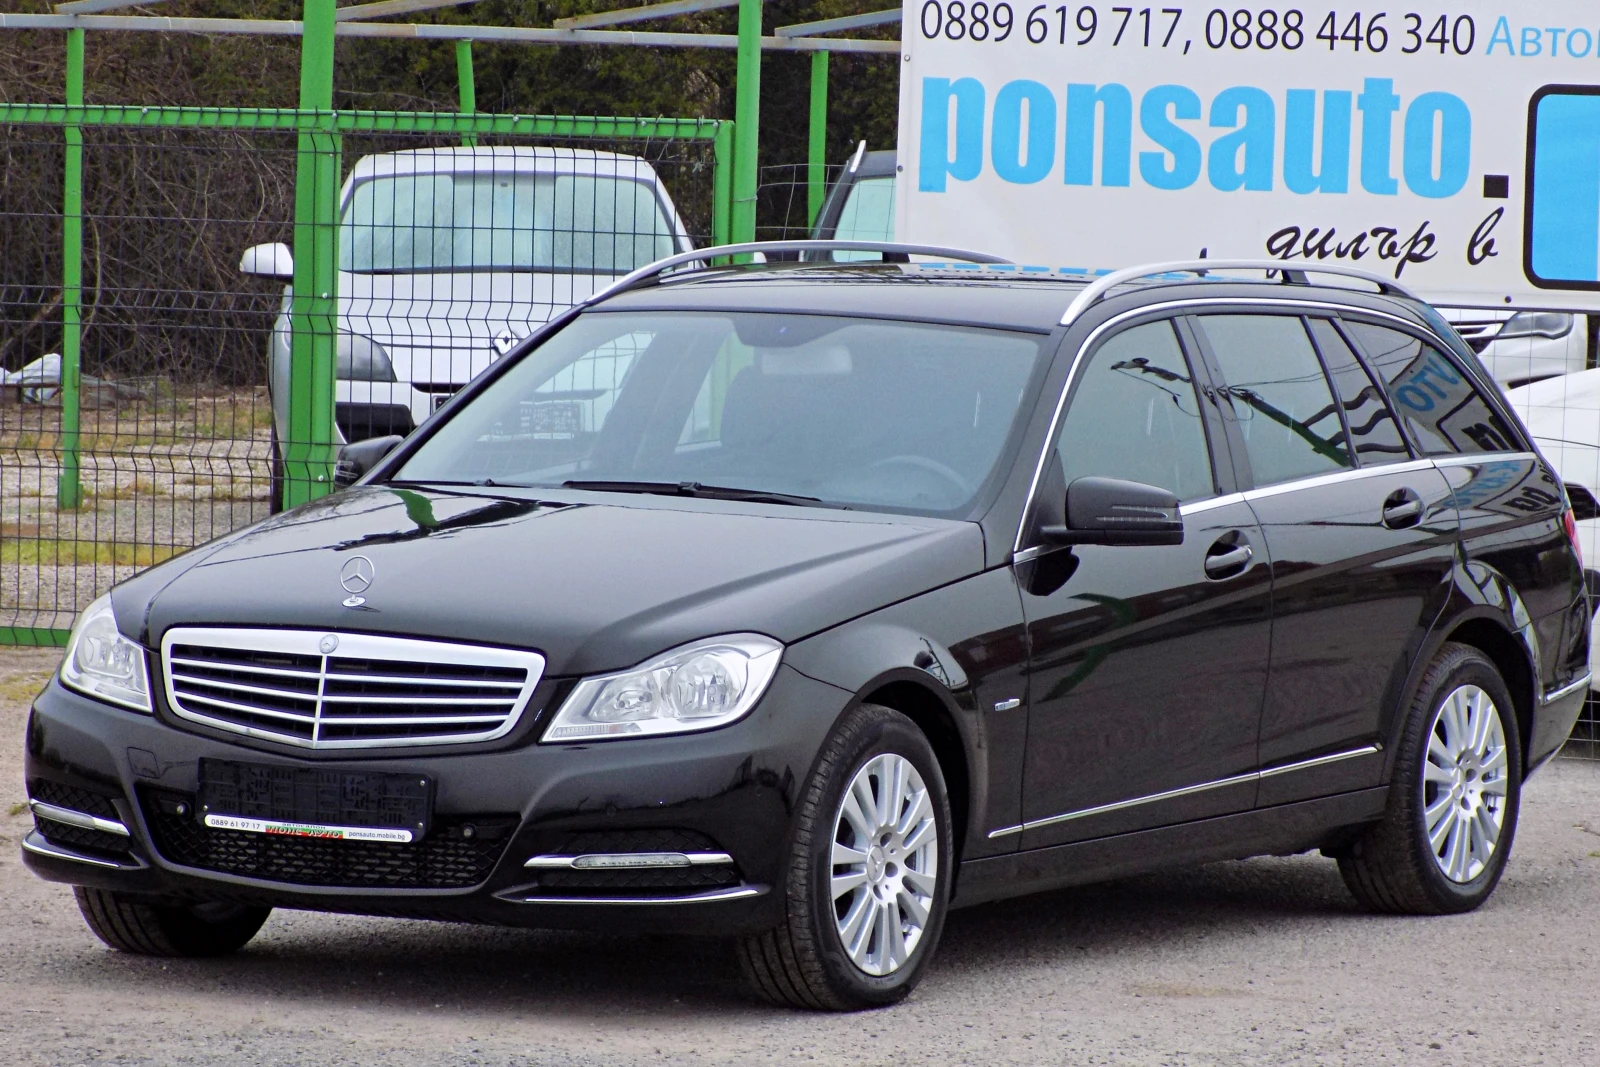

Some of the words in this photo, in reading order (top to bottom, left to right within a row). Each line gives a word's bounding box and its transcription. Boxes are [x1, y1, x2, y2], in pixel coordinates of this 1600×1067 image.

[920, 0, 1014, 42] 0889
[1025, 4, 1098, 46] 619
[1111, 7, 1192, 55] 717,
[1205, 9, 1304, 50] 0888
[1316, 11, 1389, 52] 446
[1401, 12, 1476, 55] 340
[1485, 15, 1600, 59] Авто
[1467, 206, 1505, 266] в
[210, 818, 229, 826] 0889
[230, 820, 238, 828] 61
[240, 821, 250, 829] 97
[252, 822, 261, 830] 17
[348, 831, 406, 841] ponsauto.mobile.bg
